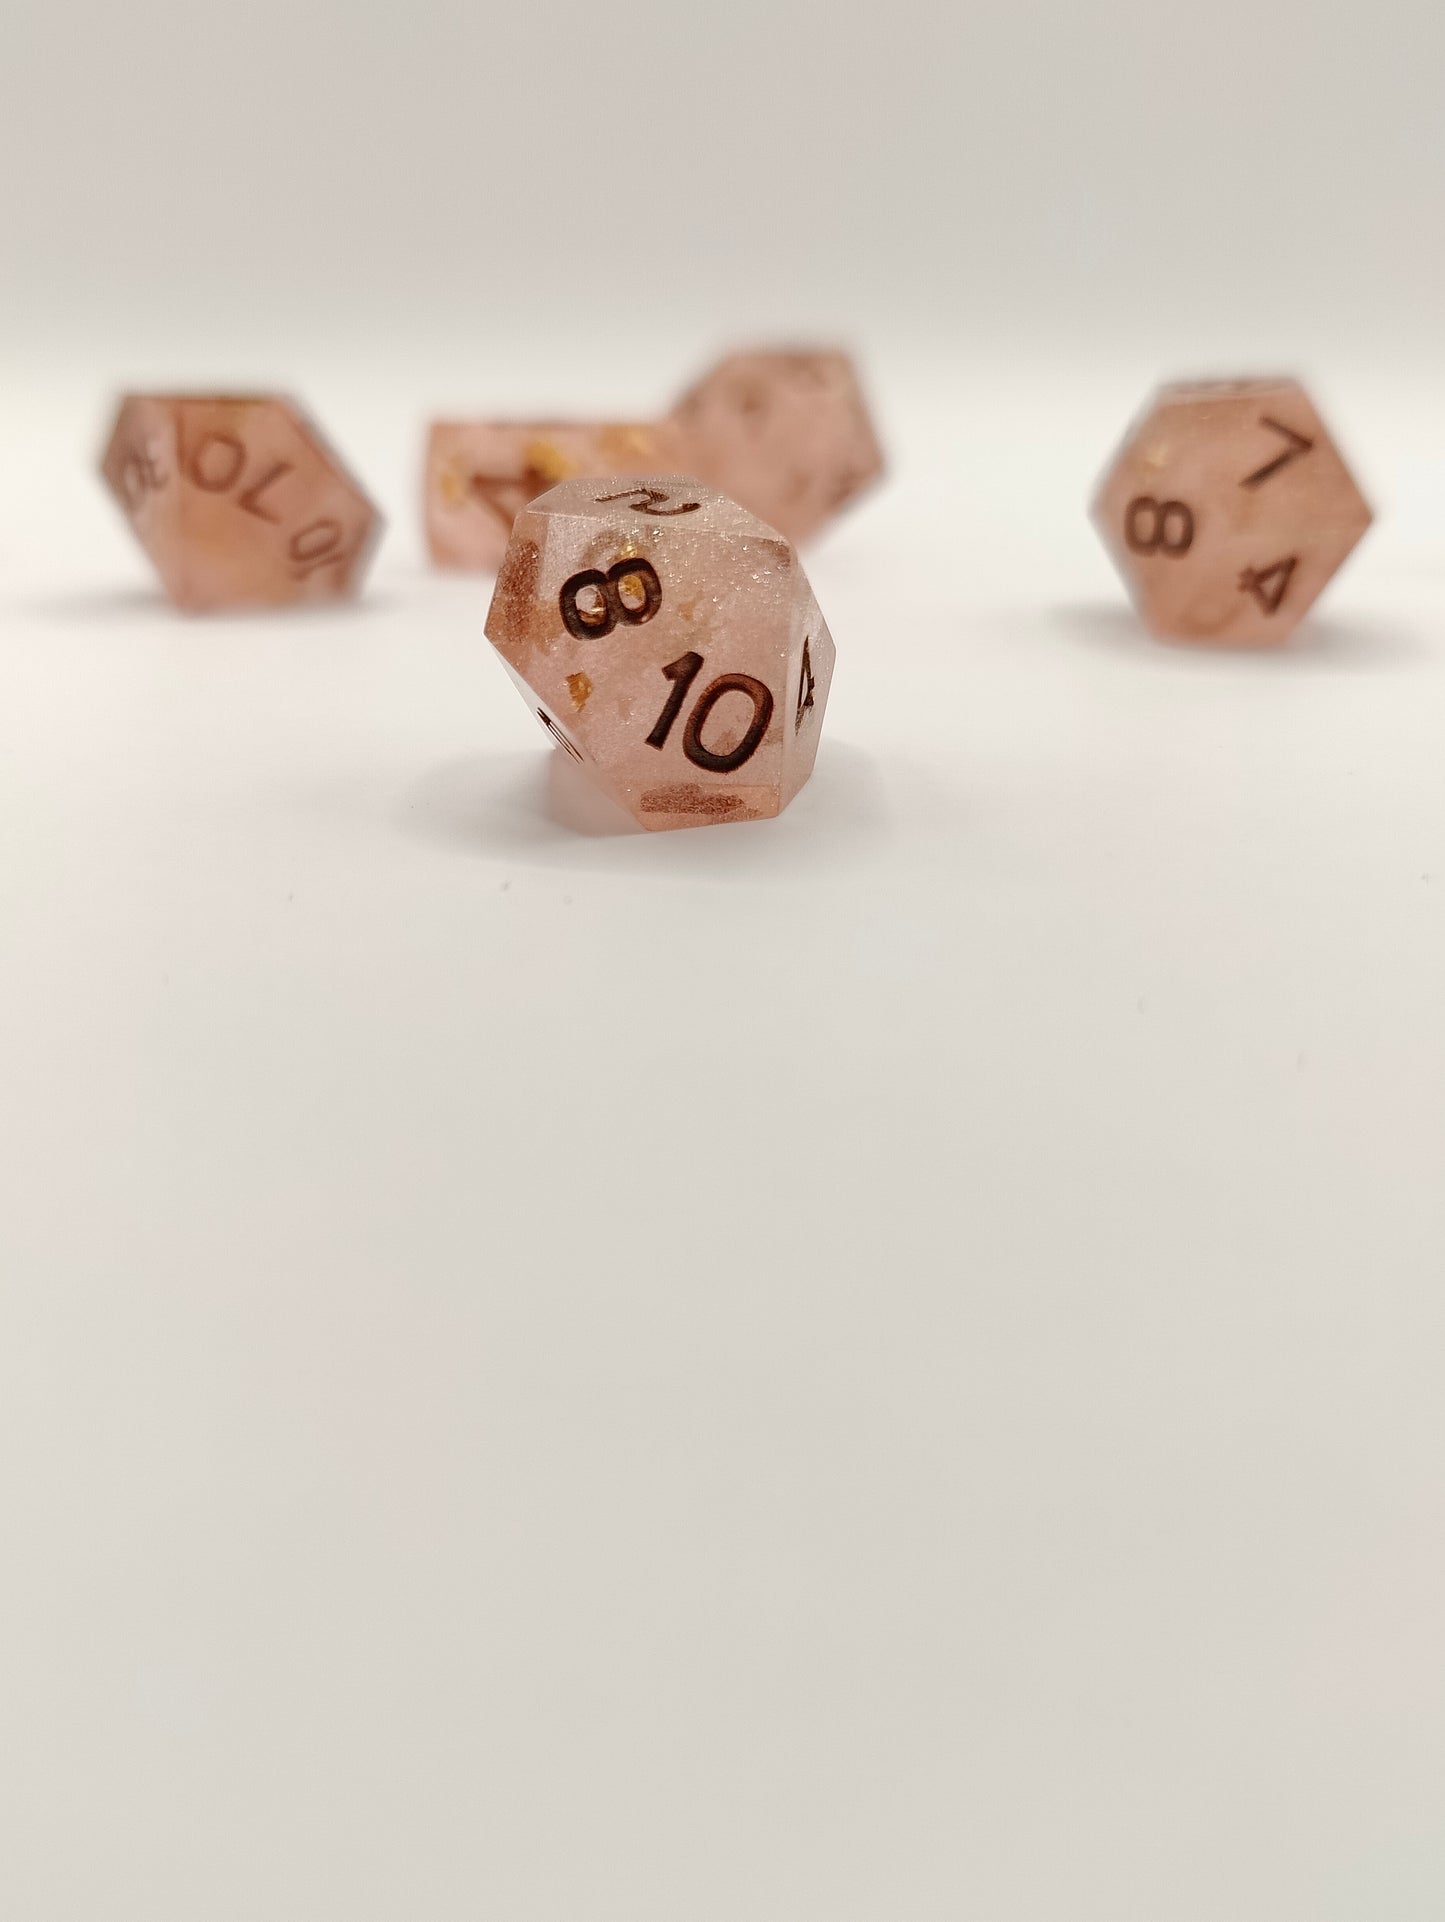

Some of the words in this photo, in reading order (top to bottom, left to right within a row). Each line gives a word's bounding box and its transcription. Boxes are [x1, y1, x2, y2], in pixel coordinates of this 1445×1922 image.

[1239, 415, 1313, 490] 7
[1124, 495, 1195, 560] 8
[559, 557, 662, 641] 8
[1237, 555, 1298, 616] 4
[644, 650, 774, 774] 10
